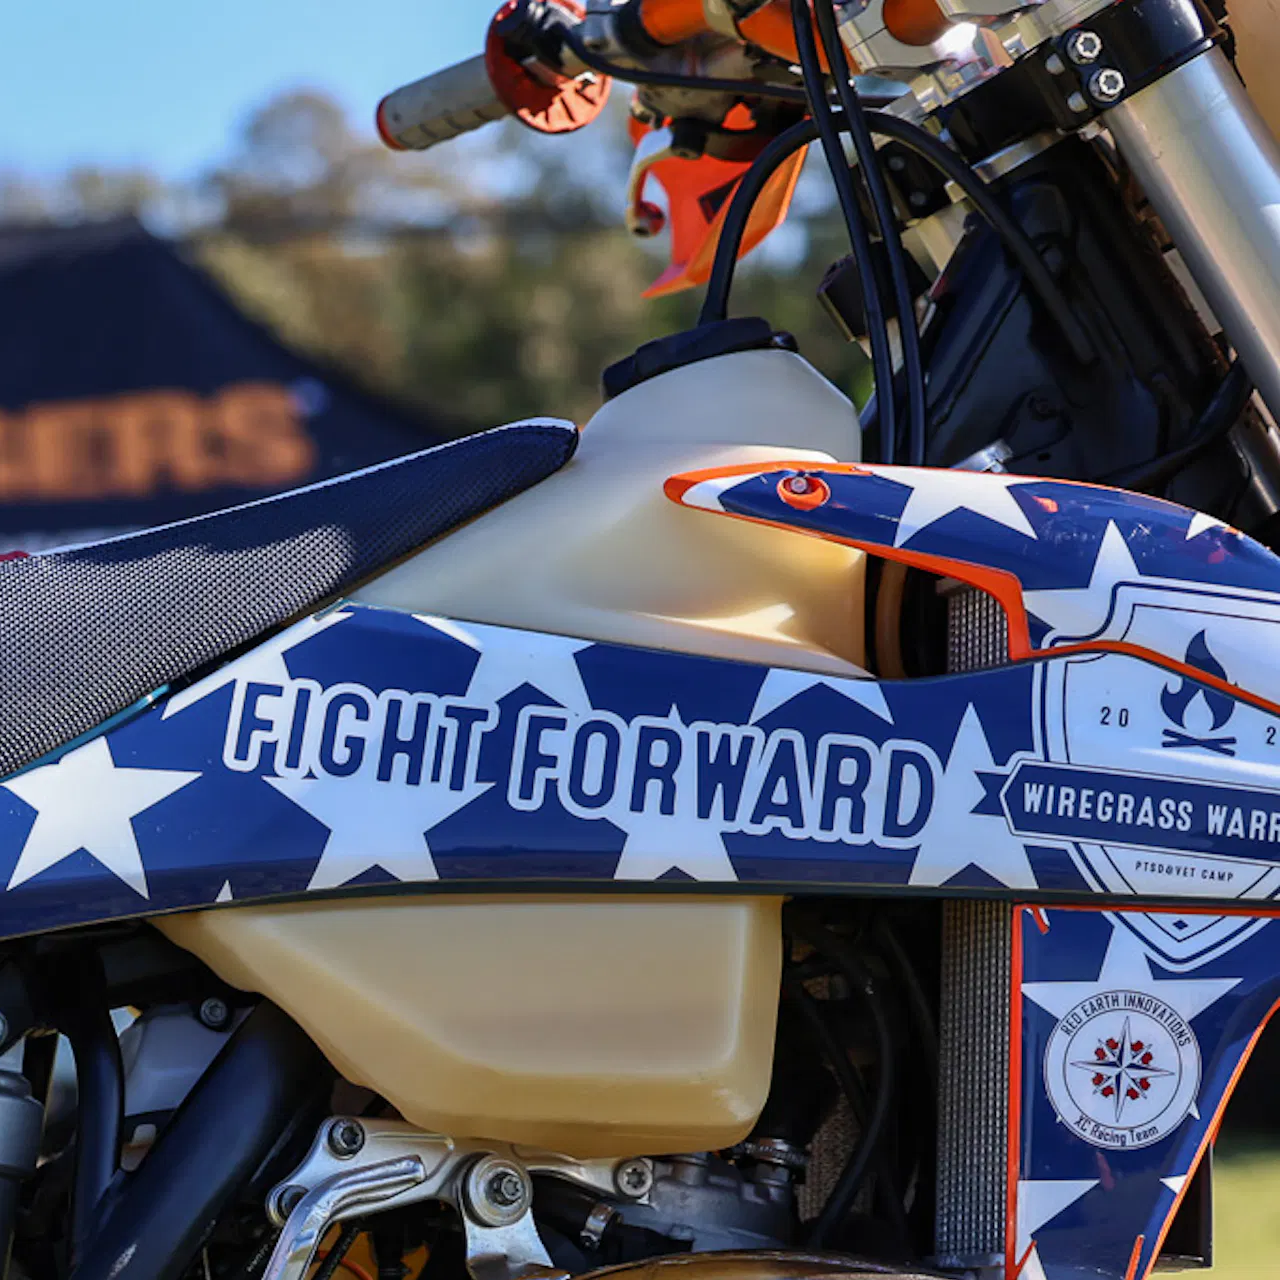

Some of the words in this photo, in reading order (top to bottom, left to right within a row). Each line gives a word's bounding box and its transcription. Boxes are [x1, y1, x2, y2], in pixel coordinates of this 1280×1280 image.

[224, 678, 498, 792] FIGHT
[506, 702, 944, 850] FORWARD
[1023, 782, 1193, 832] WIREGRASS
[1201, 869, 1234, 883] CAMP
[1060, 1012, 1083, 1036] RED
[1082, 994, 1120, 1018] EARTH
[1124, 993, 1190, 1047] INNOVATIONS
[1128, 1126, 1159, 1142] Team
